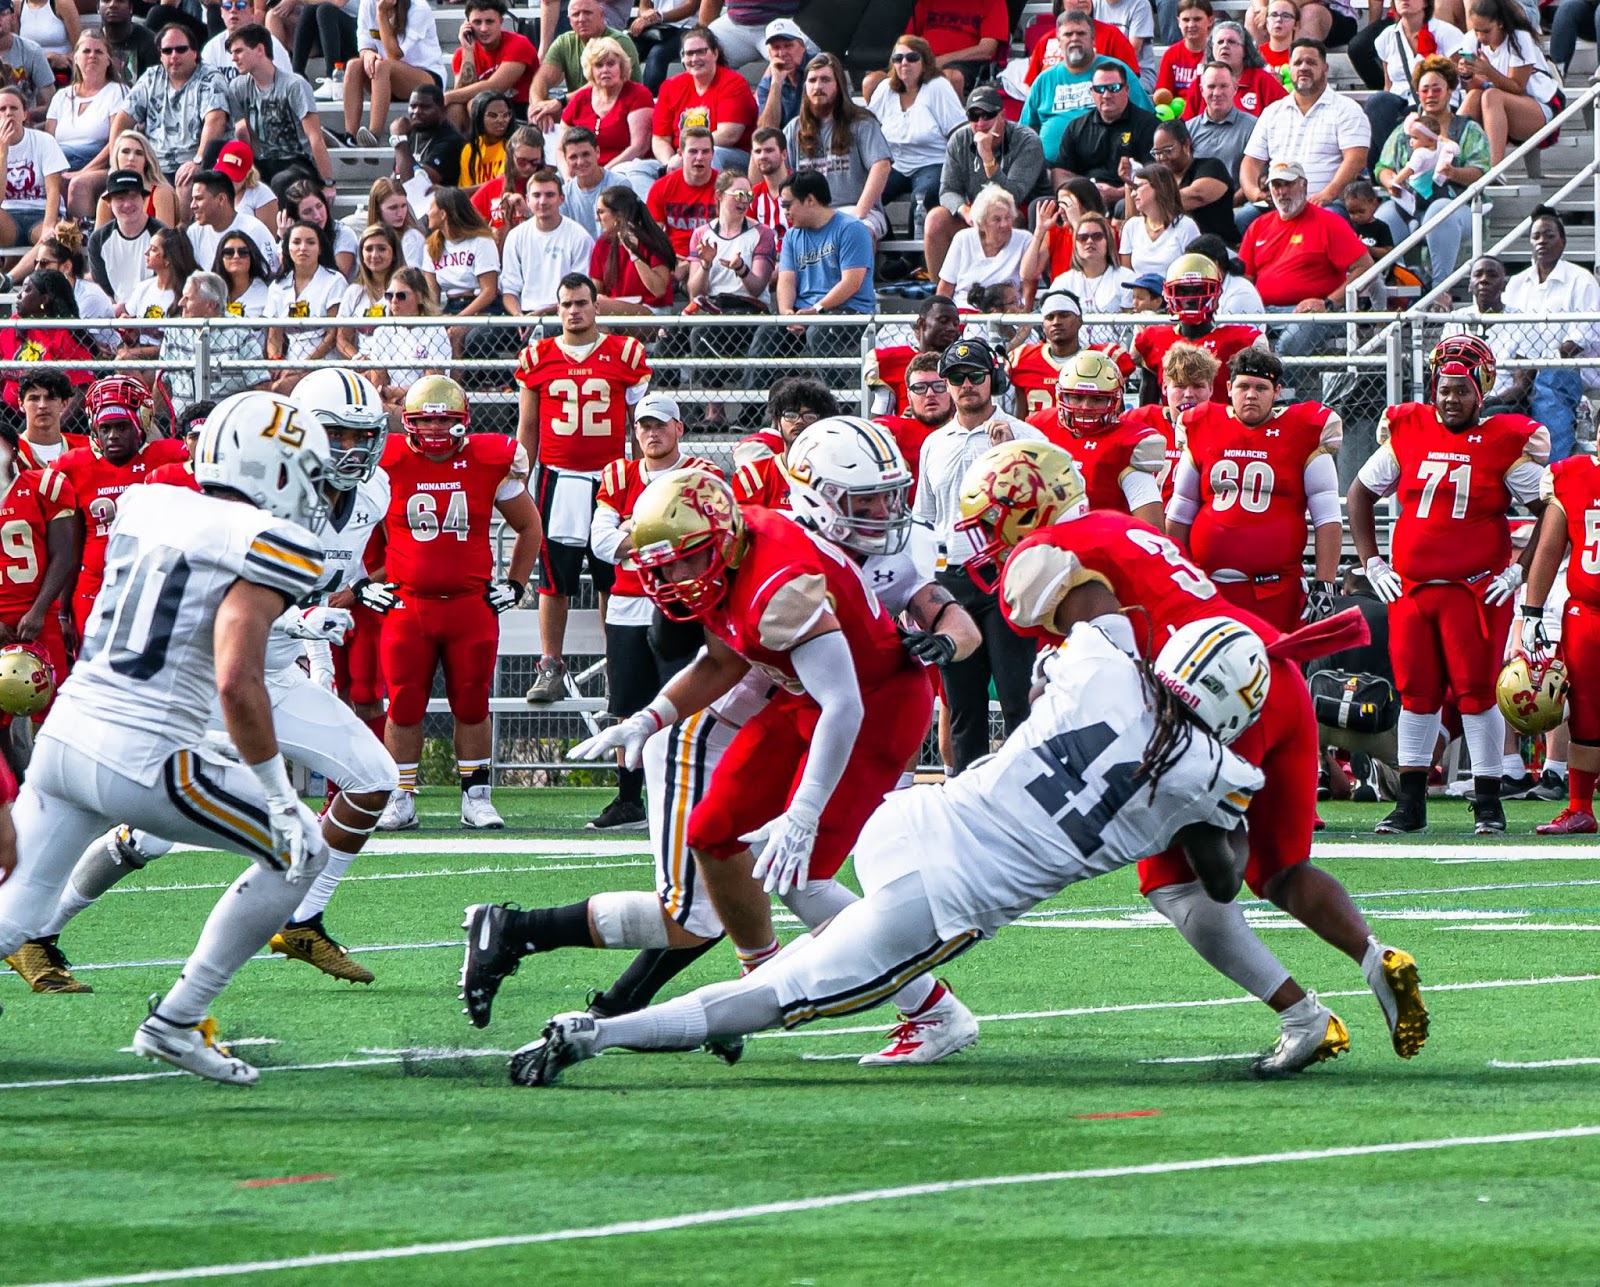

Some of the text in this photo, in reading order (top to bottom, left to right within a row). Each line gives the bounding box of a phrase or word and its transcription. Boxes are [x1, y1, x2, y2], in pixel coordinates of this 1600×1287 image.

[567, 367, 593, 376] KING'S
[259, 400, 306, 449] L
[548, 378, 612, 437] 32
[1223, 449, 1268, 460] MONARCHS
[1427, 451, 1471, 463] MONARCHS
[416, 481, 461, 491] MONARCHS
[1209, 459, 1275, 513] 60
[1416, 460, 1472, 520] 71
[406, 490, 470, 542] 64
[0, 519, 39, 585] 9
[1125, 528, 1218, 601] 3
